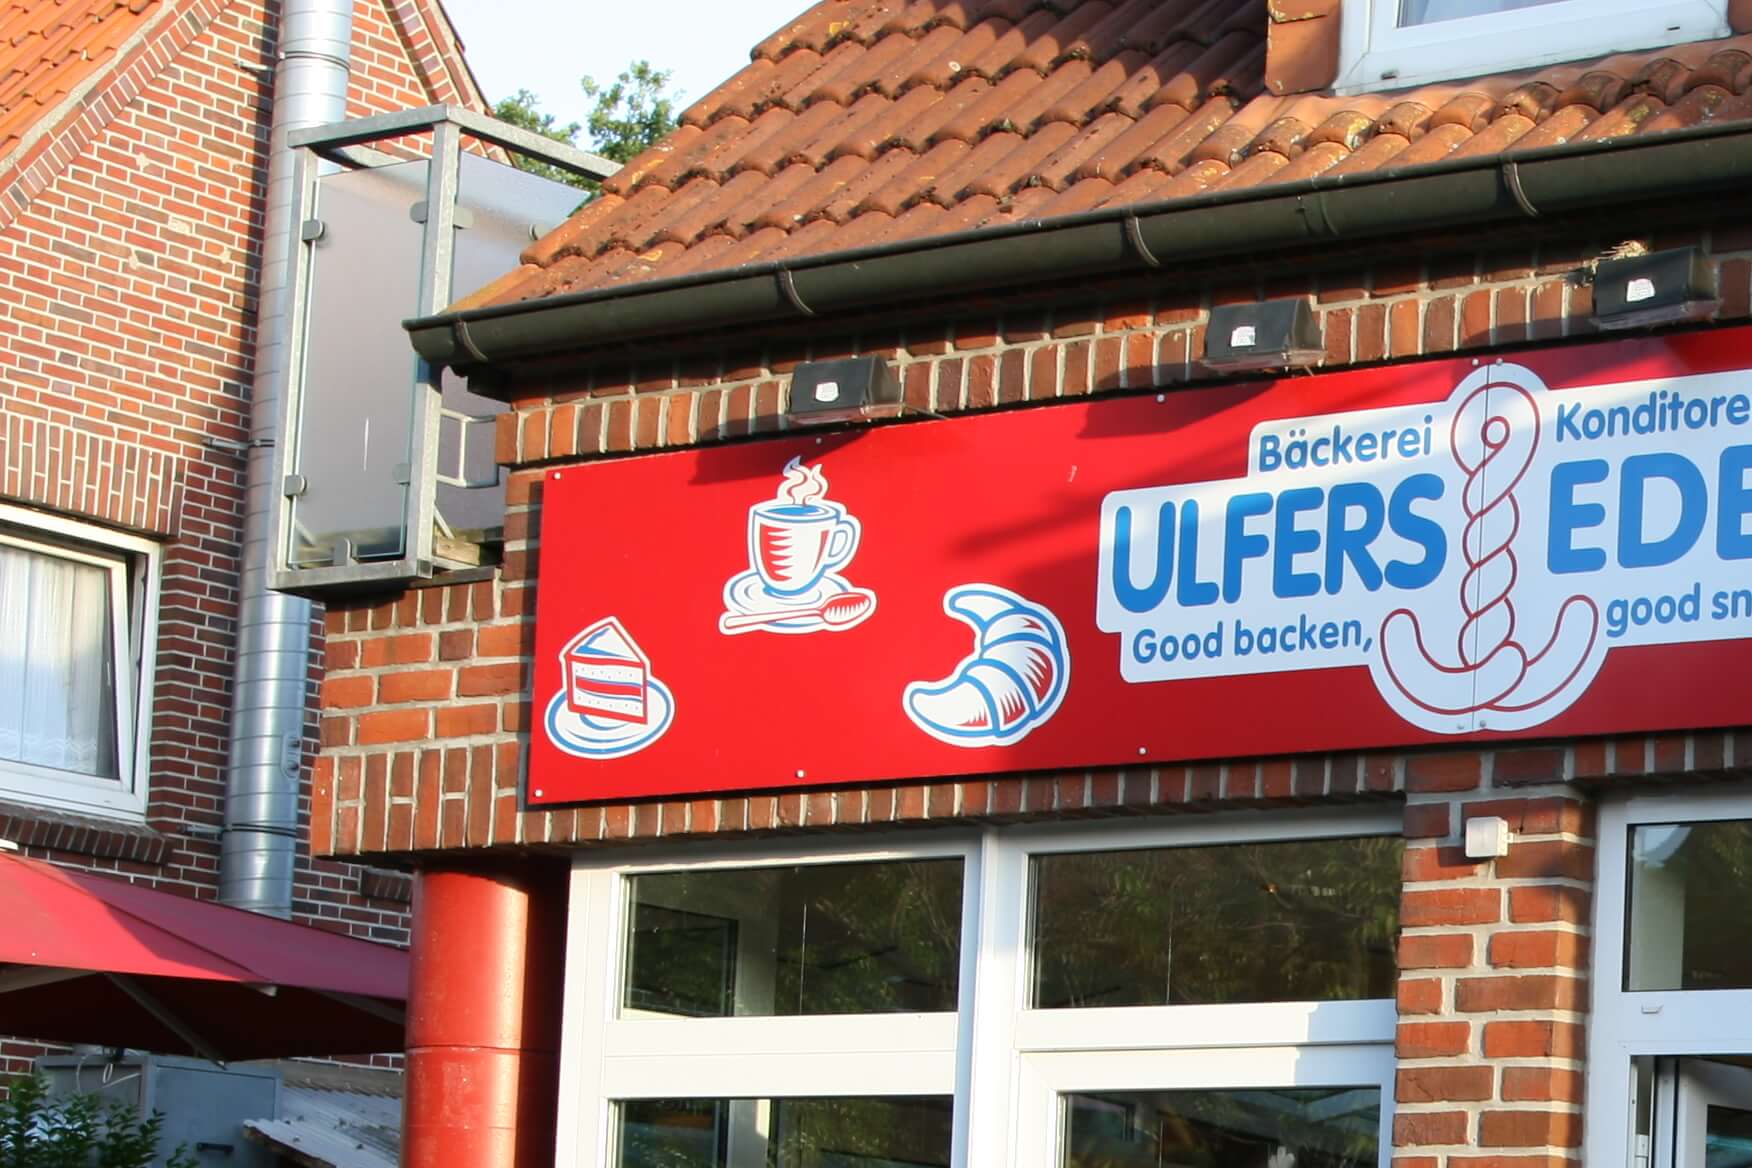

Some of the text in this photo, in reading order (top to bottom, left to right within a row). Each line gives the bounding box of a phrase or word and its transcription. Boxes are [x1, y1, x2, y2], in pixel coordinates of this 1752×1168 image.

[1259, 414, 1433, 471] Bäckerei
[1111, 472, 1448, 614] ULFERS
[1132, 623, 1224, 664] Good
[1233, 614, 1374, 657] backen,
[1605, 581, 1703, 639] good
